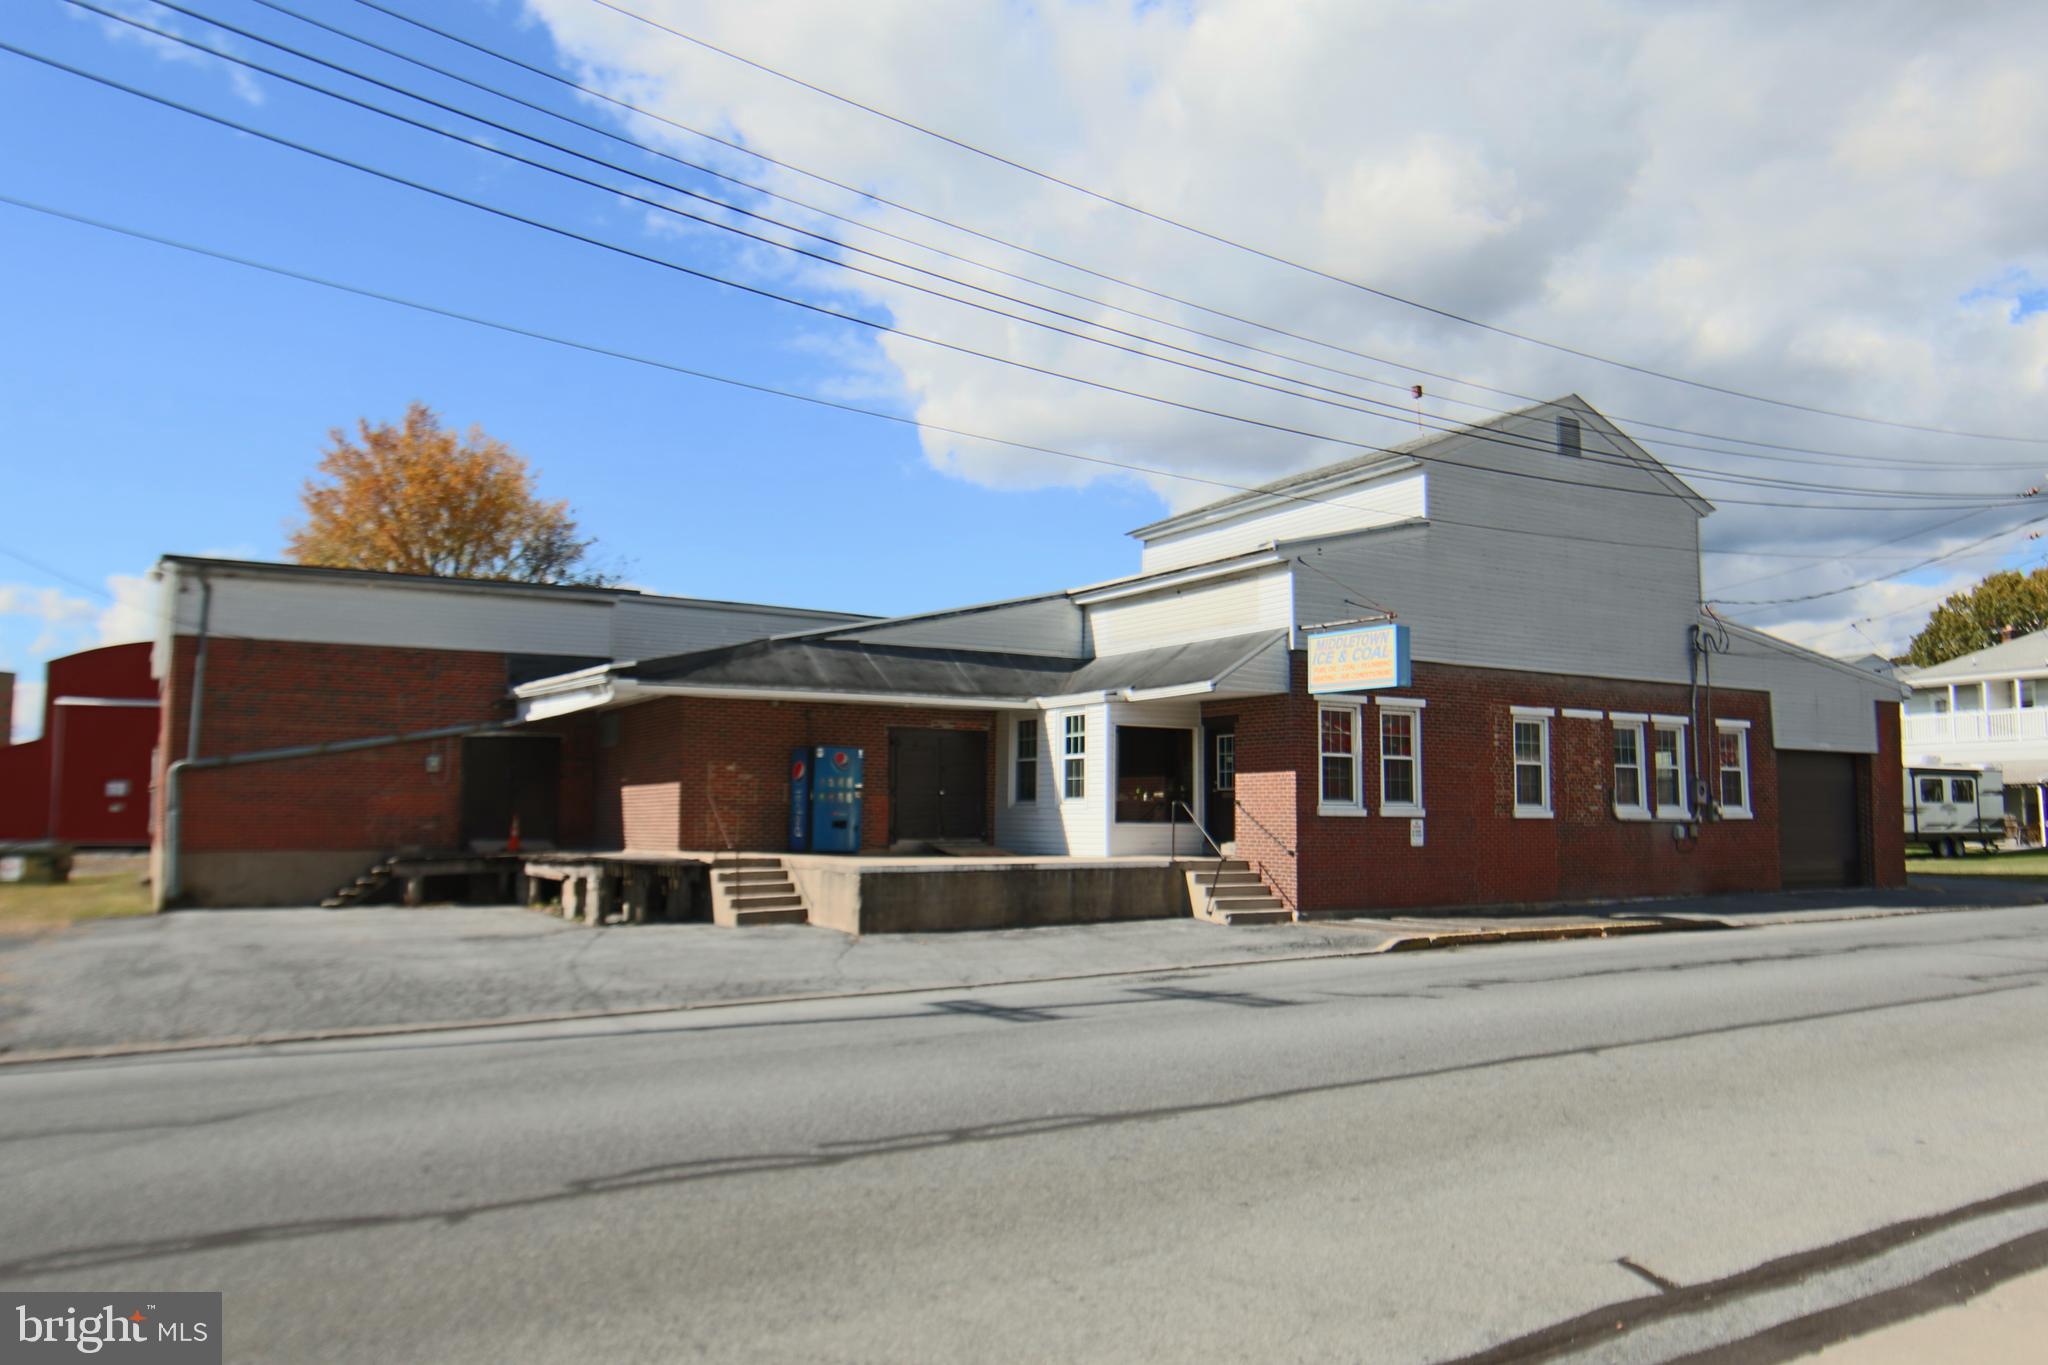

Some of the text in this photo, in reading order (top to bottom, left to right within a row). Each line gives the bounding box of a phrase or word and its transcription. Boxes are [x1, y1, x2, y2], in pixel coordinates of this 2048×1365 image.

[1316, 632, 1389, 650] MIDDLETOWN
[1313, 646, 1389, 665] ICE & COAL
